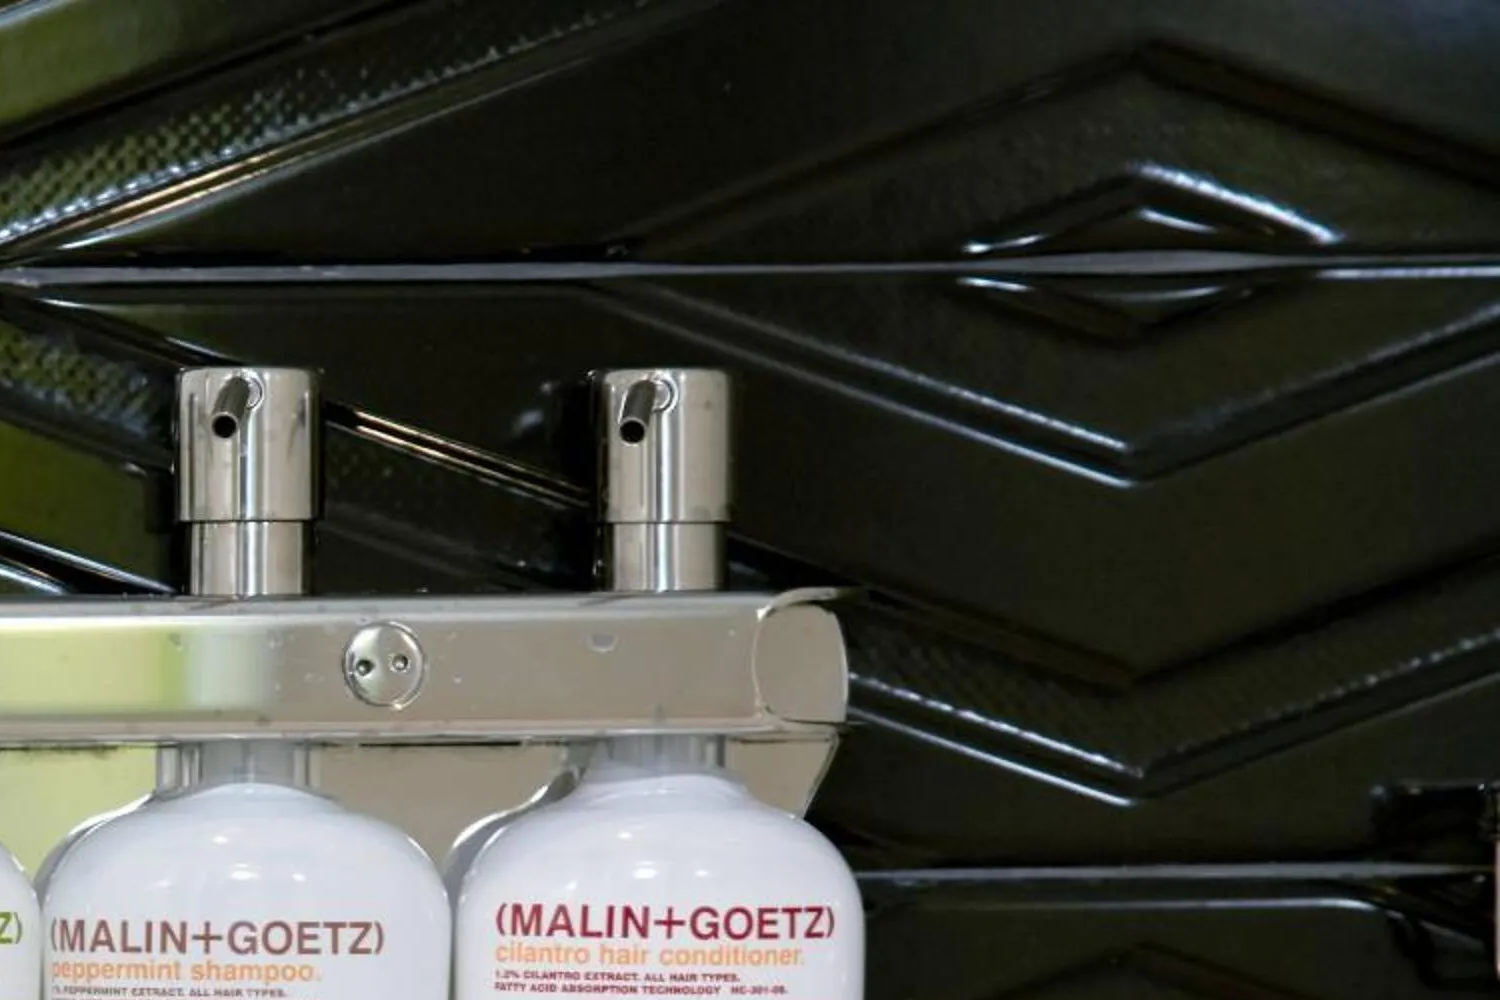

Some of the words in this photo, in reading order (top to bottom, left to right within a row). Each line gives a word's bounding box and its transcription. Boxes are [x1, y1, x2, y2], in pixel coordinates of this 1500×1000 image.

[50, 918, 385, 956] (MALIN+GOETZ)
[495, 903, 835, 941] (MALIN+GOETZ)
[494, 942, 589, 965] cilantro
[599, 943, 650, 966] hair
[659, 944, 803, 967] conditioner.
[51, 960, 181, 983] peppermint
[190, 960, 321, 984] shampoo.
